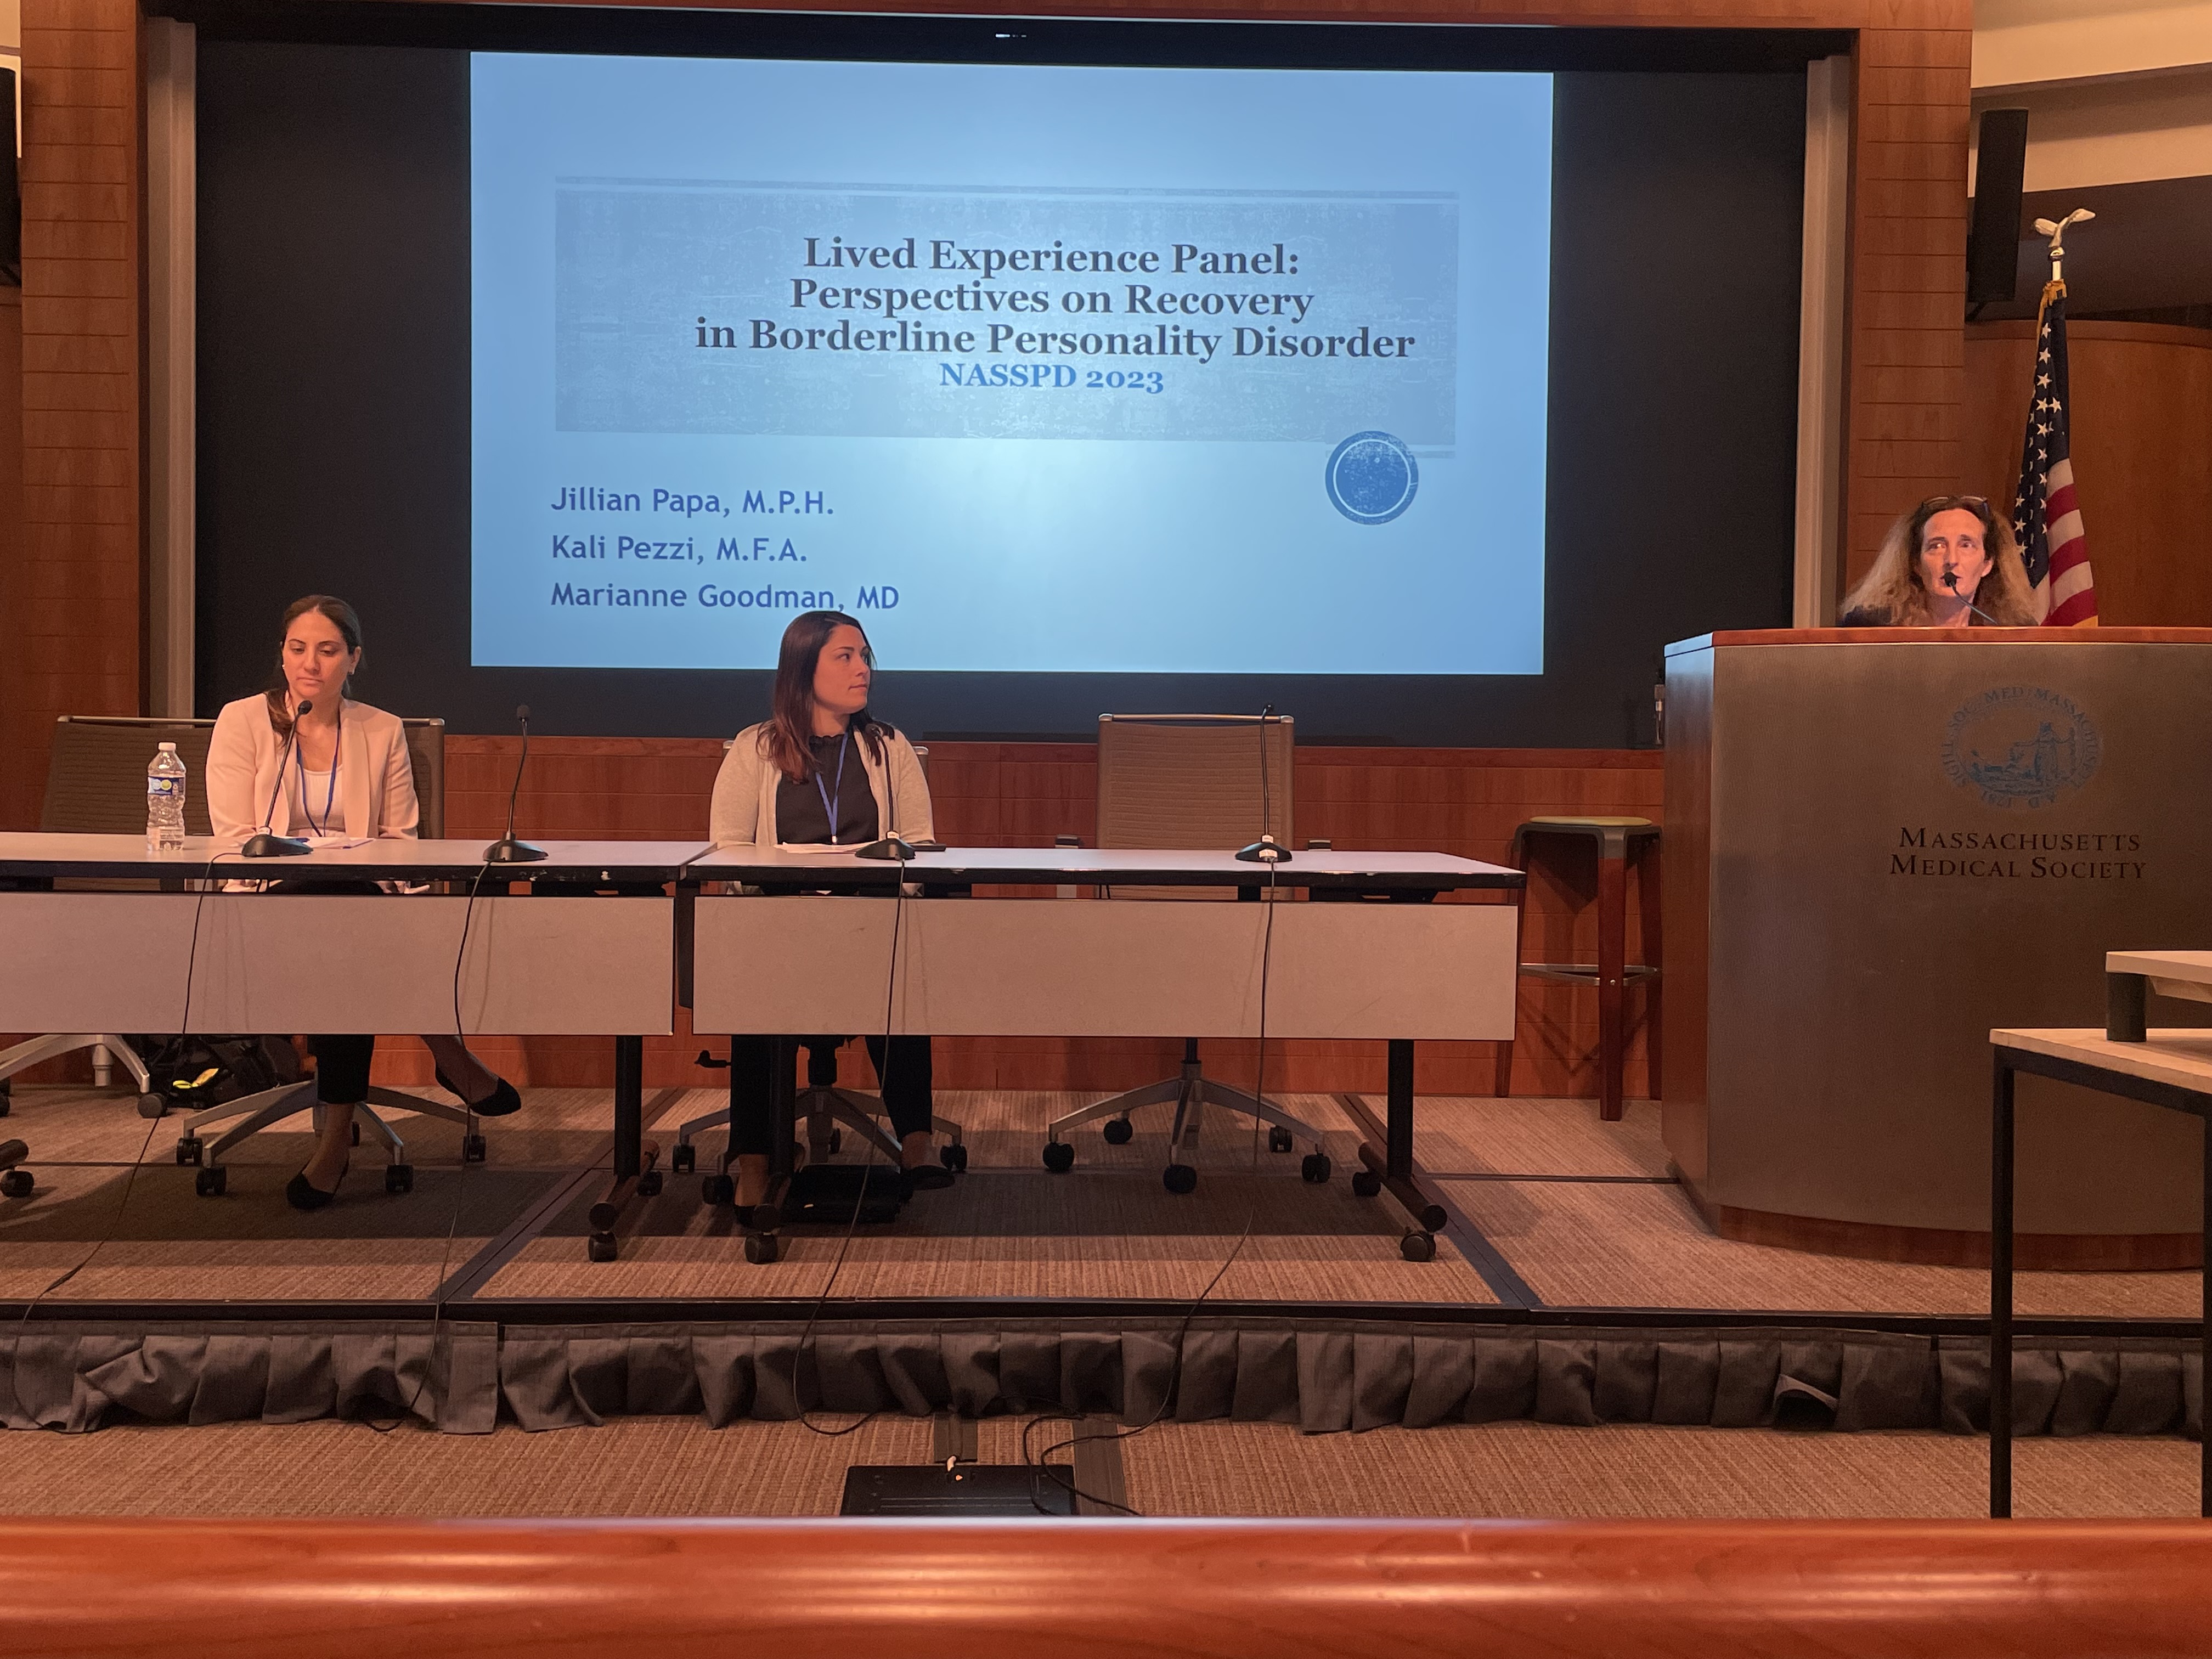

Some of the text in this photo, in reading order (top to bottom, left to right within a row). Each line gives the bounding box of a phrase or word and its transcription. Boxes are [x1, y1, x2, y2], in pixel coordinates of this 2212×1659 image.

[803, 236, 1298, 279] Lived Experience Panel:
[789, 278, 1315, 324] Perspectives on Recovery
[695, 316, 1415, 364] in Borderline Personality Disorder
[940, 363, 1164, 394] NASSPD 2023
[551, 487, 834, 518] Jillian Papa, M.P.H.
[552, 534, 807, 565] Kali Pezzi, M.F.A.
[551, 582, 899, 612] Marianne Goodman, MD
[1899, 827, 2140, 851] MASSACHUSETTS
[1891, 854, 2147, 879] MEDICAL SOCIETY
